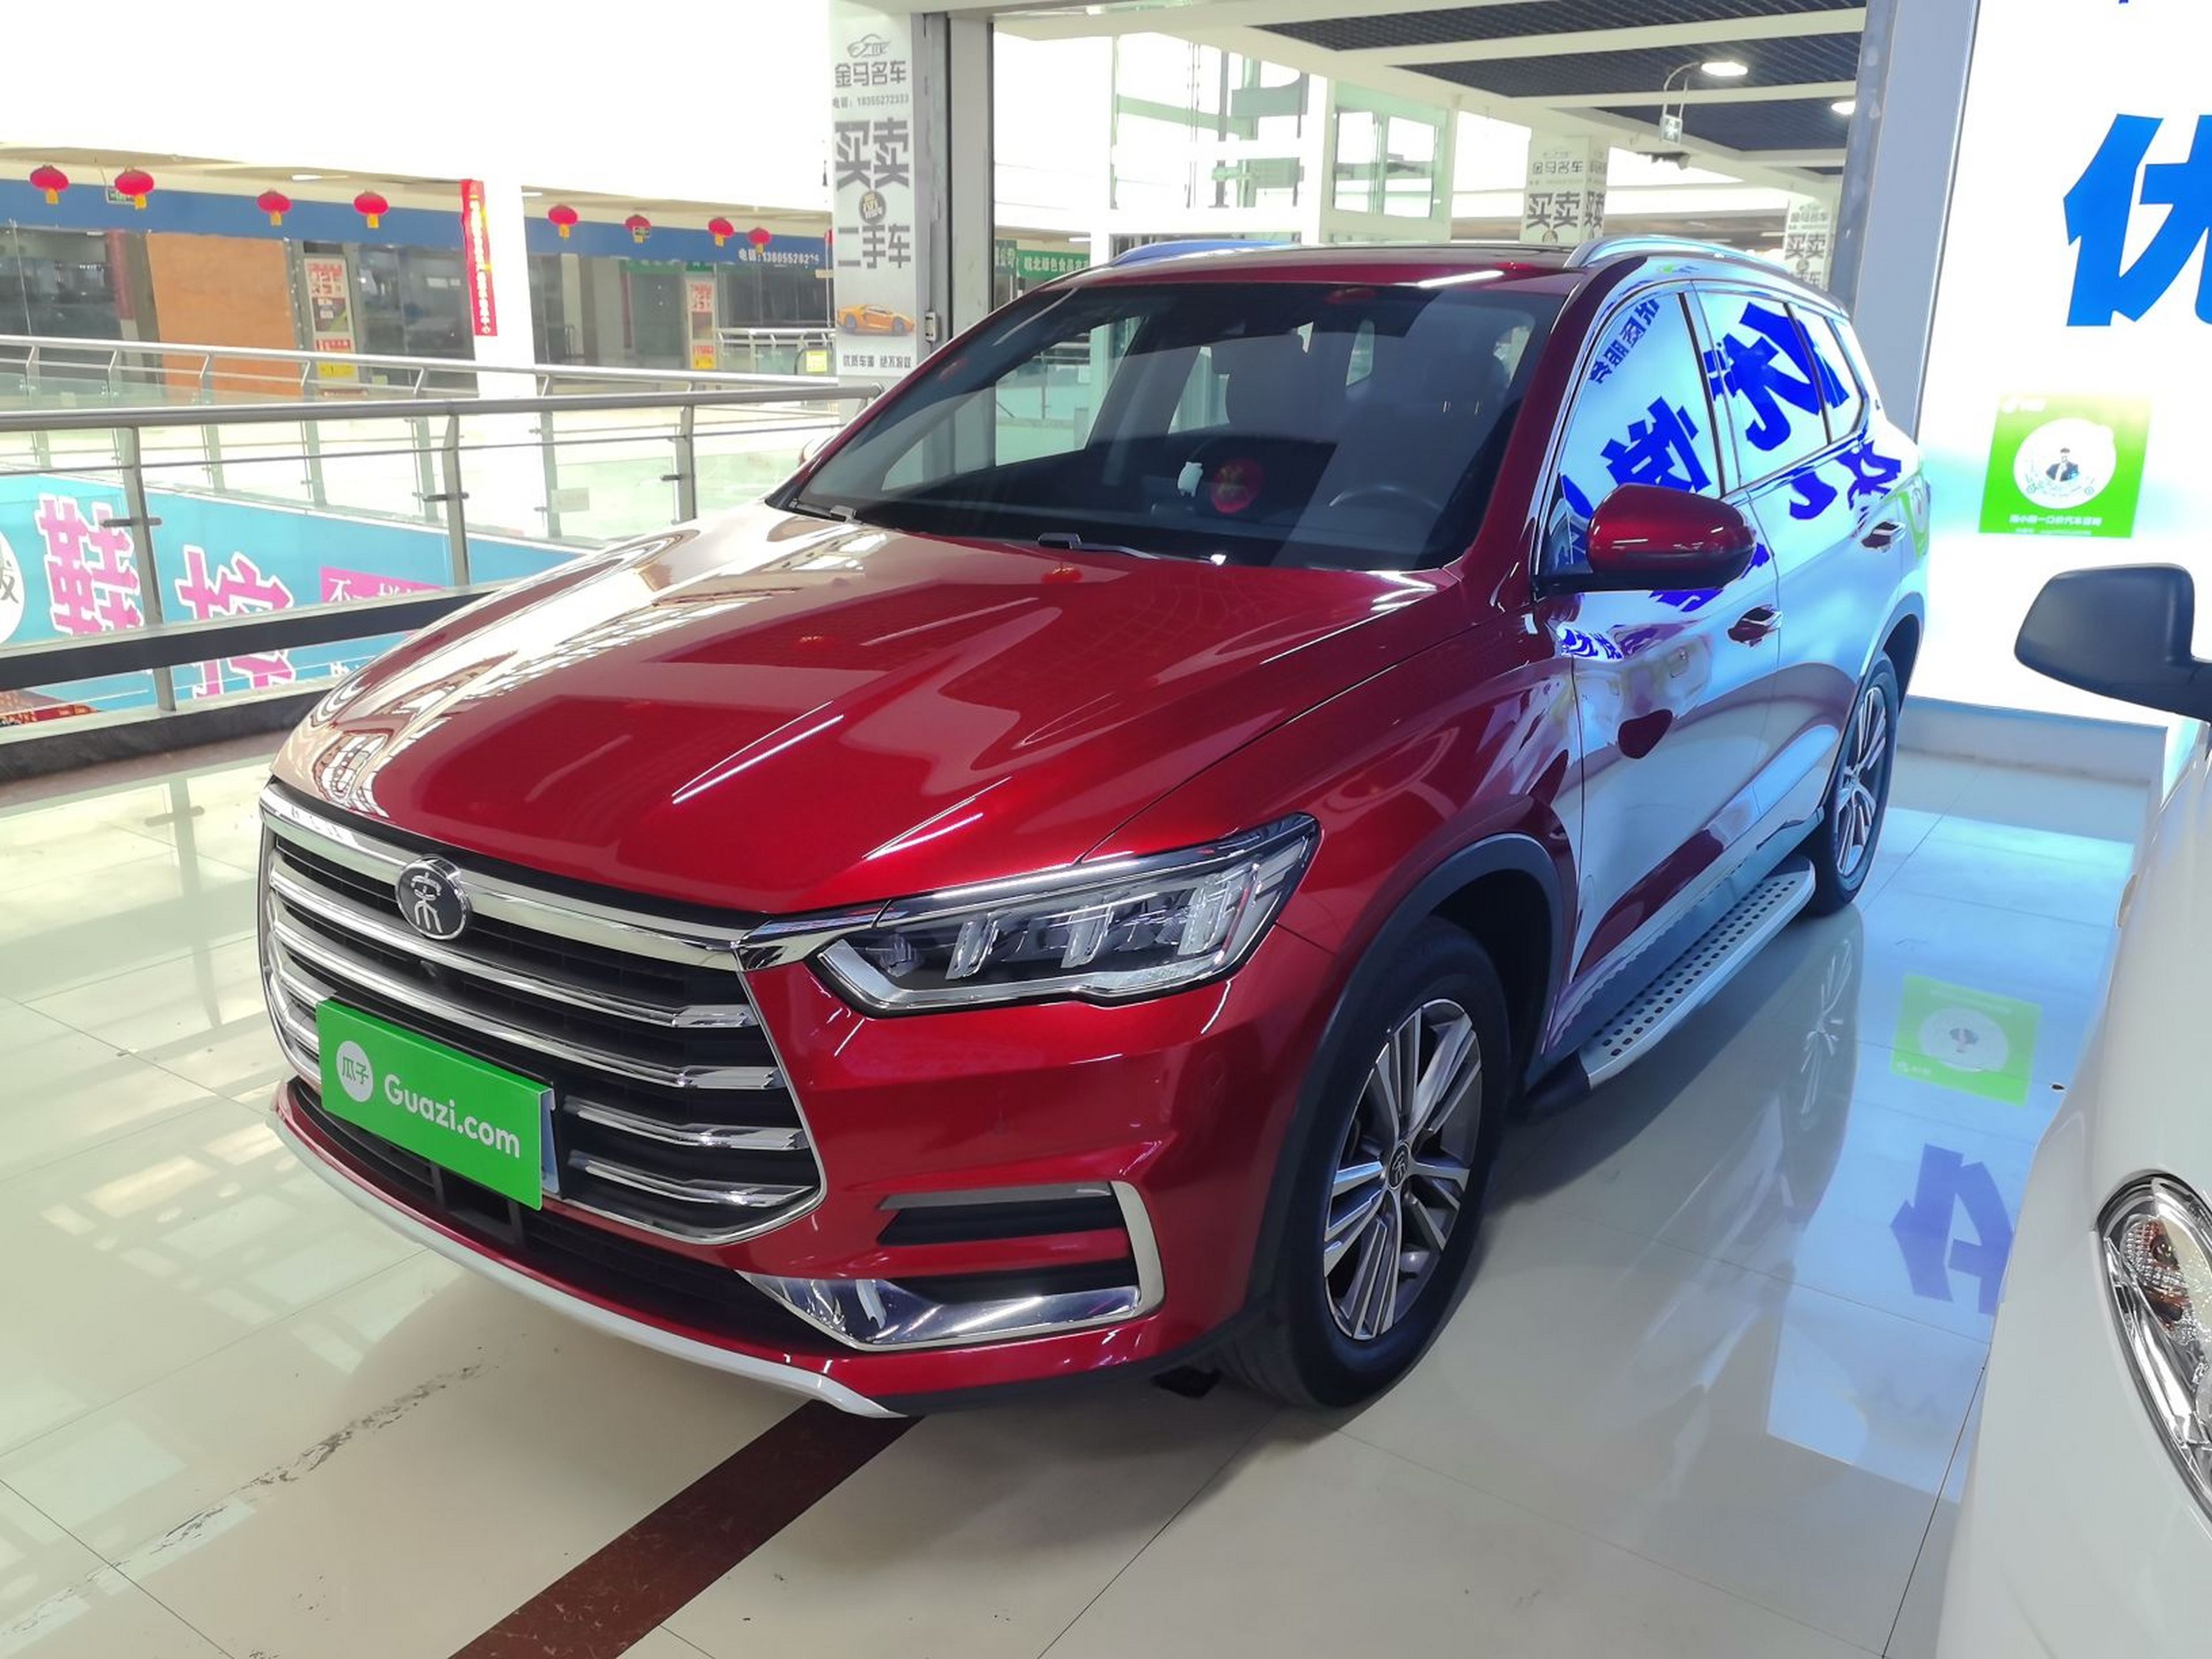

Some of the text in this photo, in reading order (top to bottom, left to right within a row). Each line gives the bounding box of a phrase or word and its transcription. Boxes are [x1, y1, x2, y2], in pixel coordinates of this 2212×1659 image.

[835, 60, 907, 88] 金马名车
[835, 118, 910, 191] 买卖
[1526, 191, 1581, 229] 买卖
[837, 224, 912, 269] 二手车
[342, 1056, 370, 1086] 瓜子
[384, 1074, 520, 1159] Guazi.com
